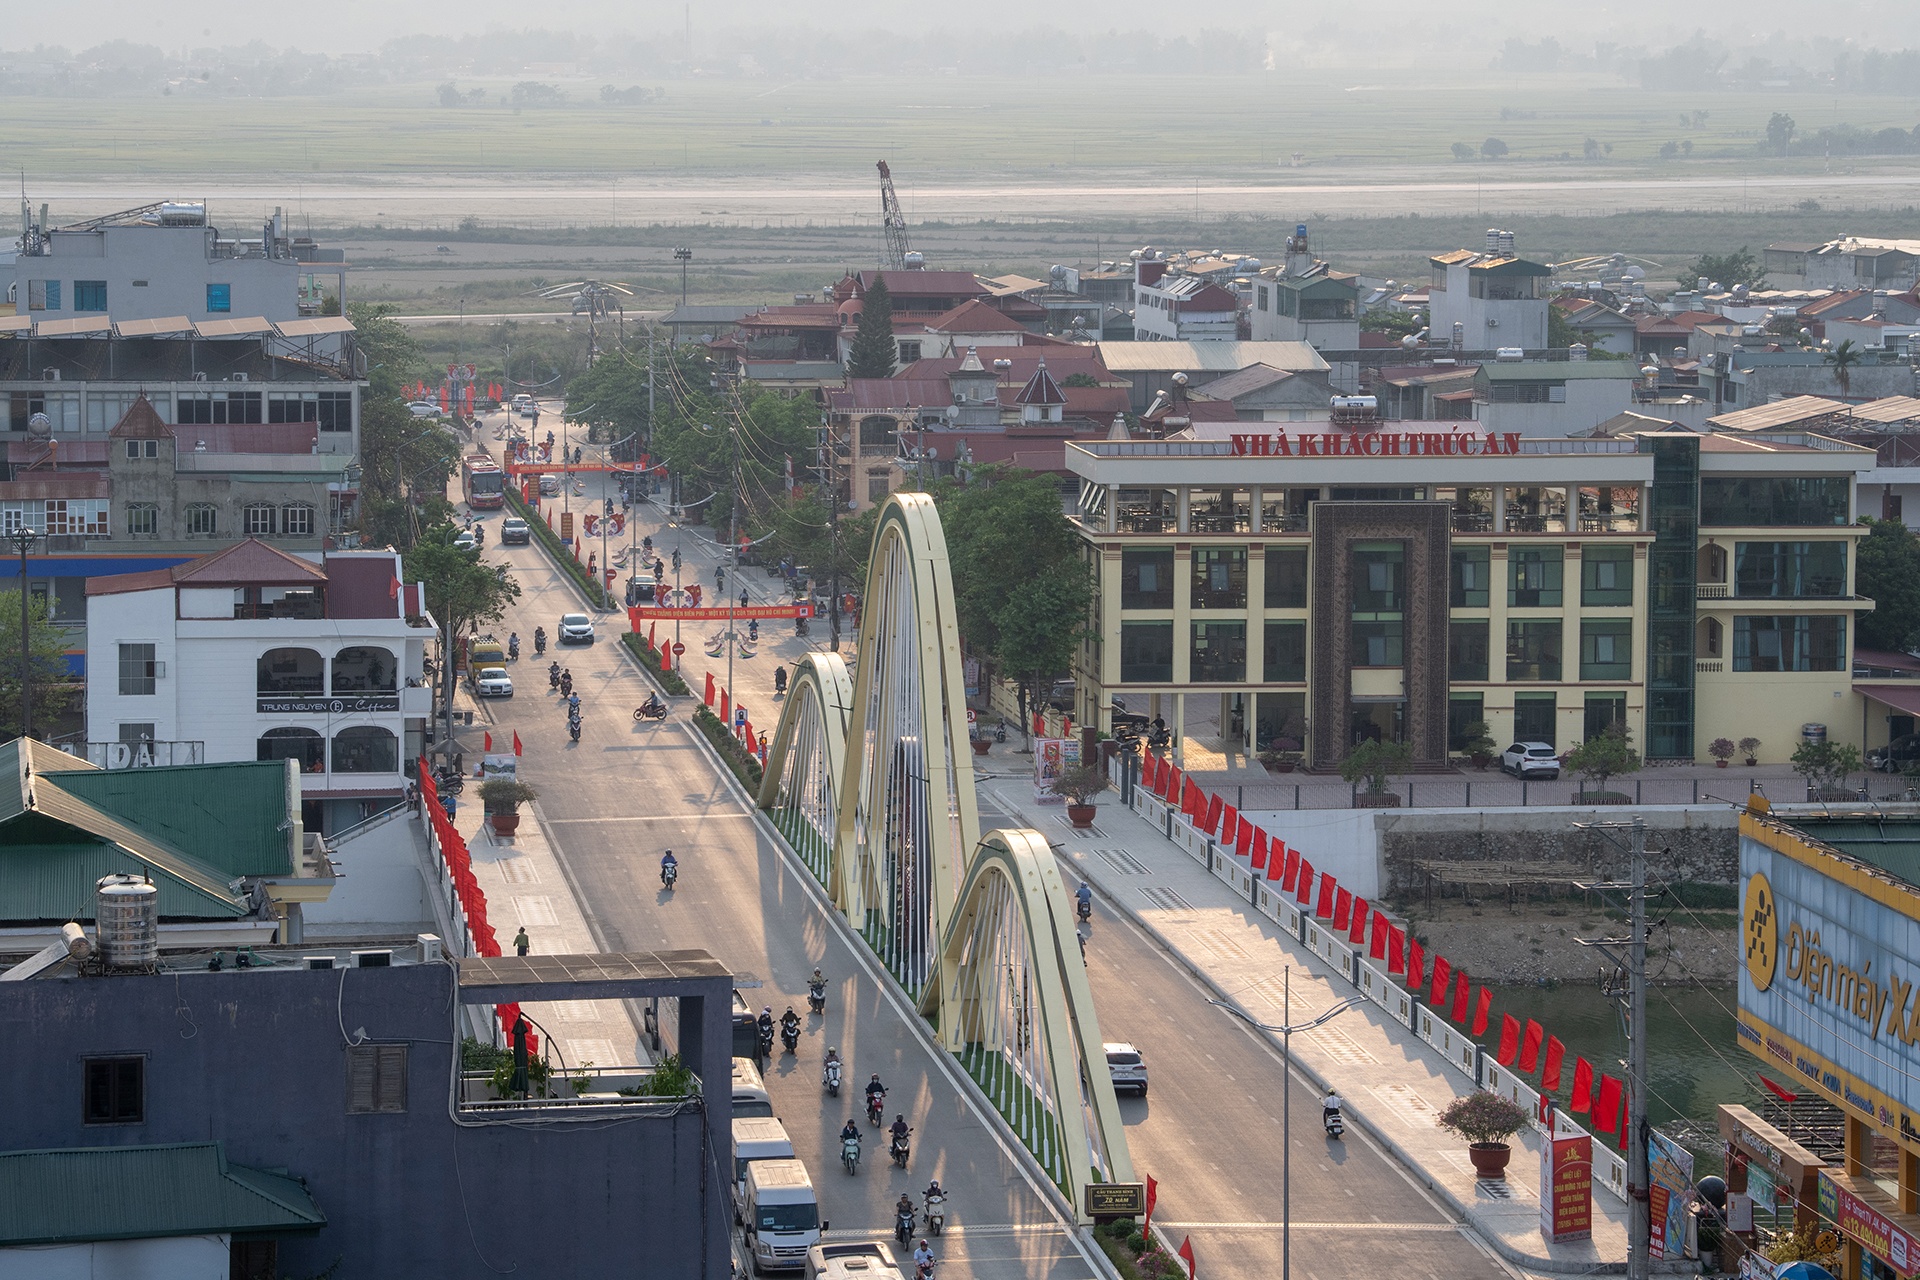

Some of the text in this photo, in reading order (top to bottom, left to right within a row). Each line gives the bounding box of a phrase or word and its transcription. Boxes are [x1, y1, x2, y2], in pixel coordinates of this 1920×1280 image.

[1229, 425, 1523, 457] NHÀ KHÁCH TRÚC AN
[262, 703, 290, 711] TRUNG
[292, 703, 327, 711] NGUYEN
[1784, 920, 1833, 1004] Điện
[1835, 959, 1888, 1040] máy
